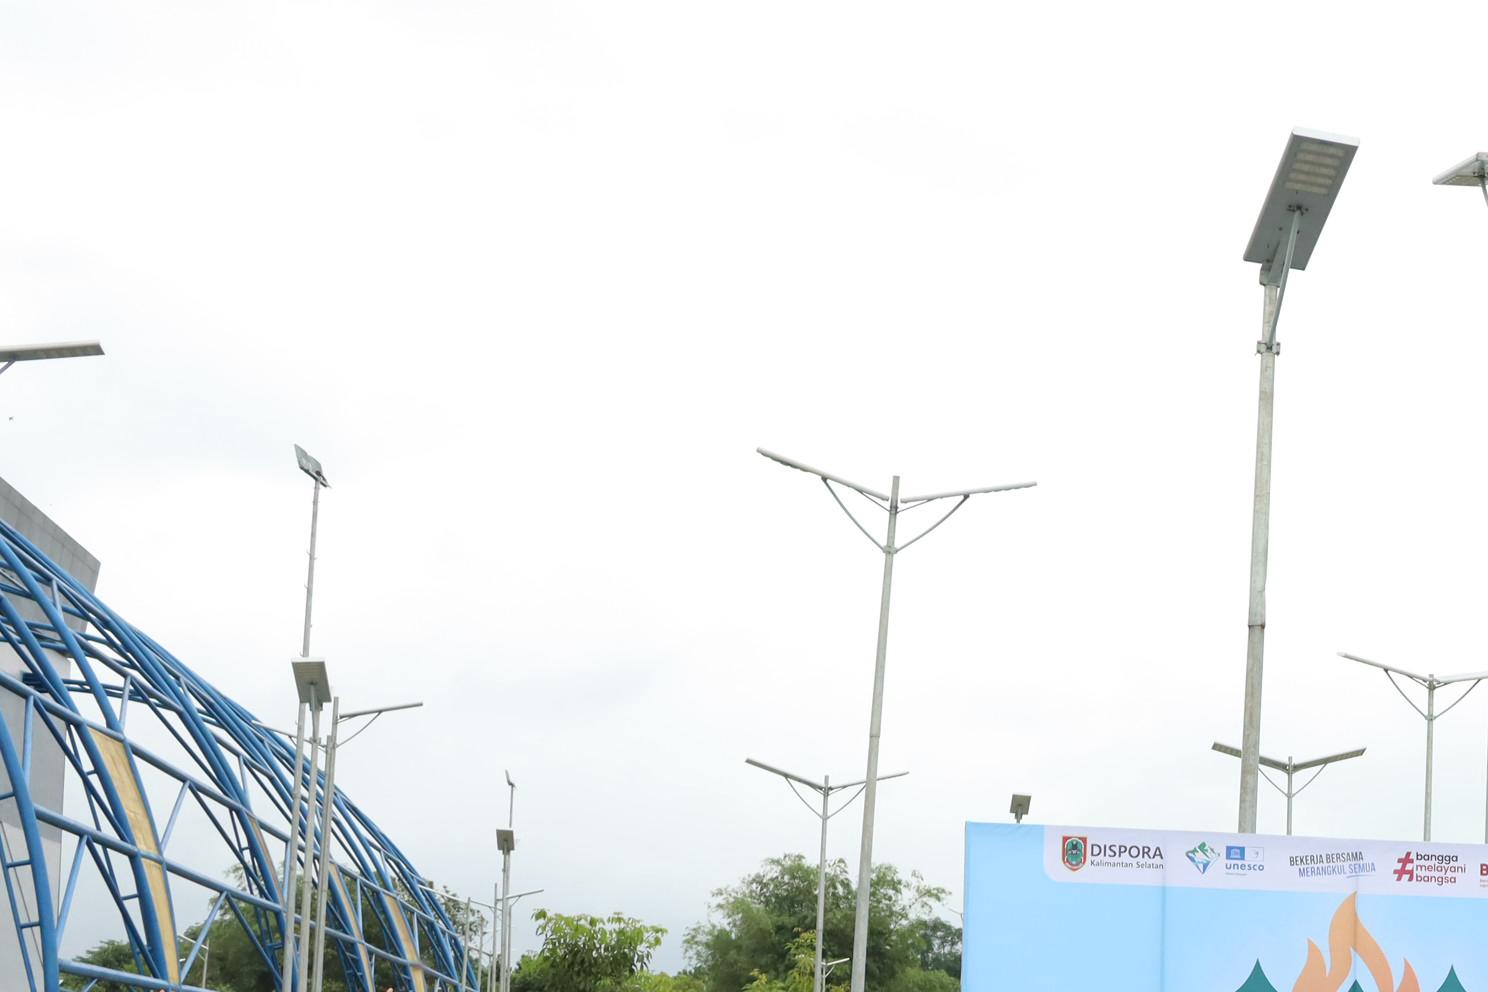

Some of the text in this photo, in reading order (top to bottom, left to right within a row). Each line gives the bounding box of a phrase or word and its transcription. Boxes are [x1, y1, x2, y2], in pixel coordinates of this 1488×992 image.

[1090, 843, 1164, 860] DISPORA
[1090, 859, 1164, 870] Kalimantan Selatan
[1289, 851, 1364, 867] BEKERJA BERSAMA
[1416, 852, 1459, 865] bangga
[1225, 863, 1265, 872] unesco
[1298, 862, 1376, 878] MERANGKUL SEMUA
[1416, 863, 1466, 876] melayani
[1416, 873, 1457, 886] bangsa
